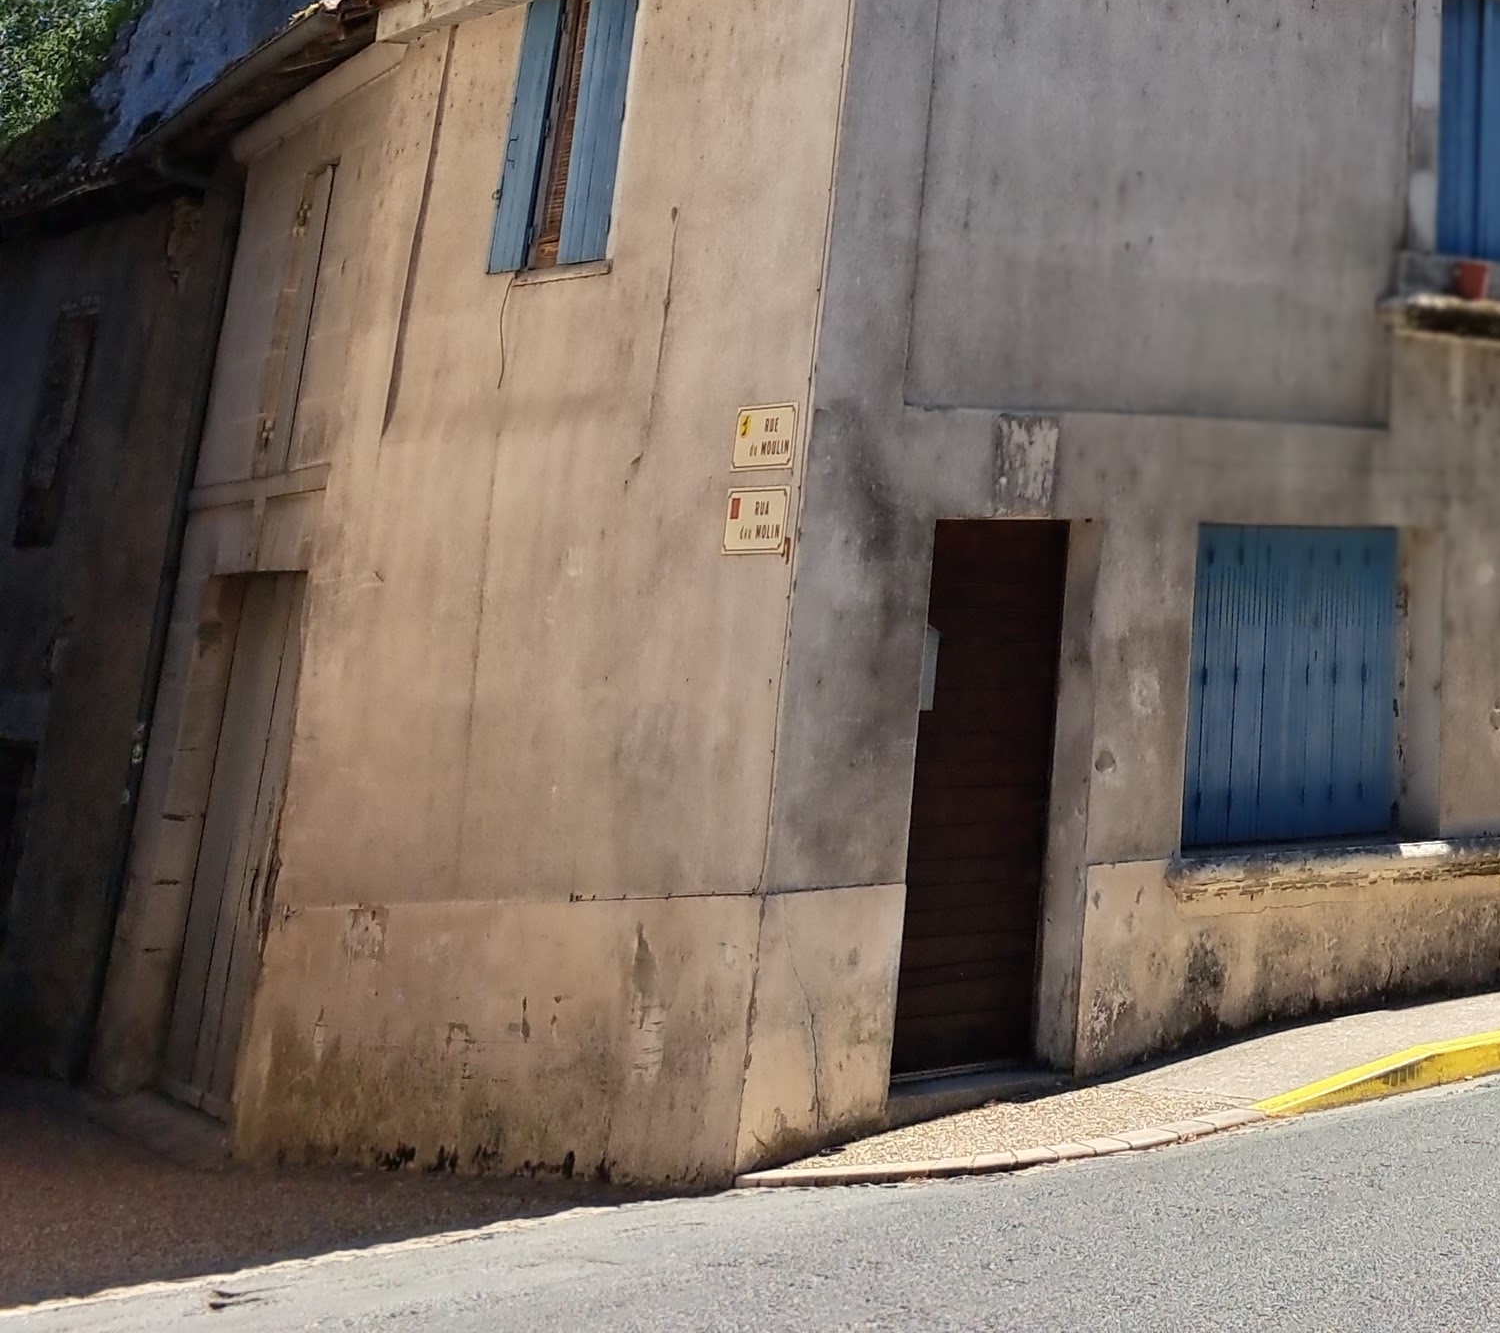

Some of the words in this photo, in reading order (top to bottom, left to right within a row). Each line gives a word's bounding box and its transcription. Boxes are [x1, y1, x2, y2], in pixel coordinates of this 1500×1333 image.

[764, 417, 780, 433] RUE
[749, 442, 758, 456] du
[760, 439, 790, 456] MOULIN
[754, 500, 770, 516] RUA
[755, 523, 781, 539] MOLIN
